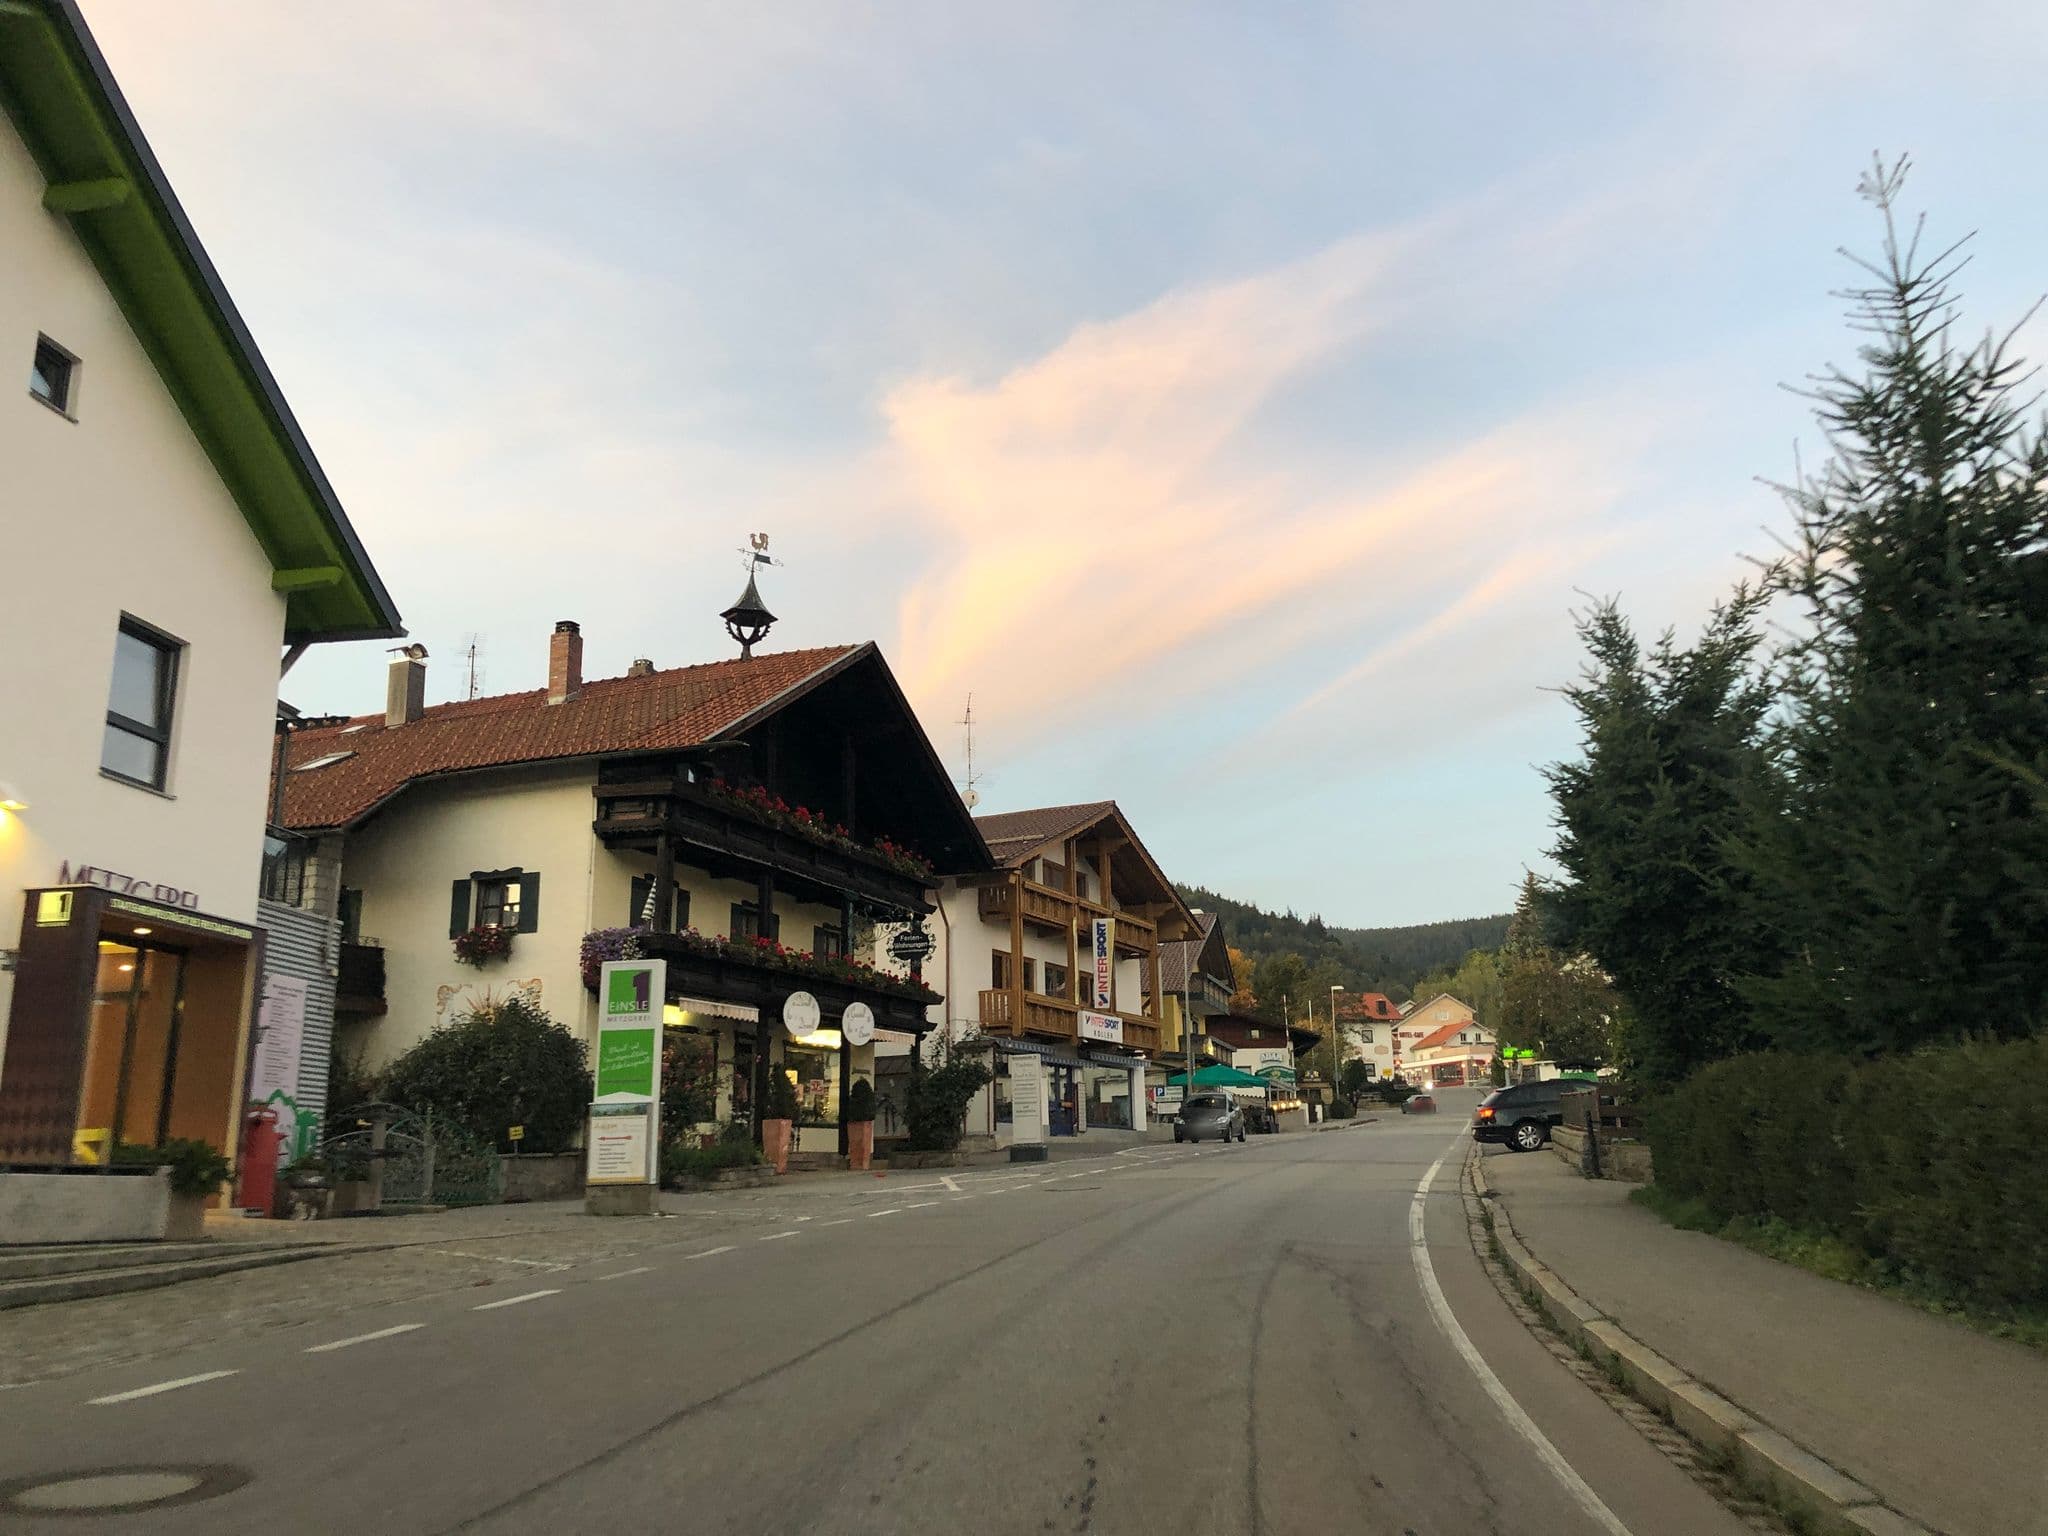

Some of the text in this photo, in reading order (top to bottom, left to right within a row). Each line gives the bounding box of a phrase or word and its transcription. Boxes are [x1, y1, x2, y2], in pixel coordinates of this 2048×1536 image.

[1096, 922, 1108, 993] INTERSPORT
[609, 1000, 649, 1012] EINSLE
[1090, 1016, 1119, 1030] INTERSPORT
[1157, 1088, 1163, 1096] P
